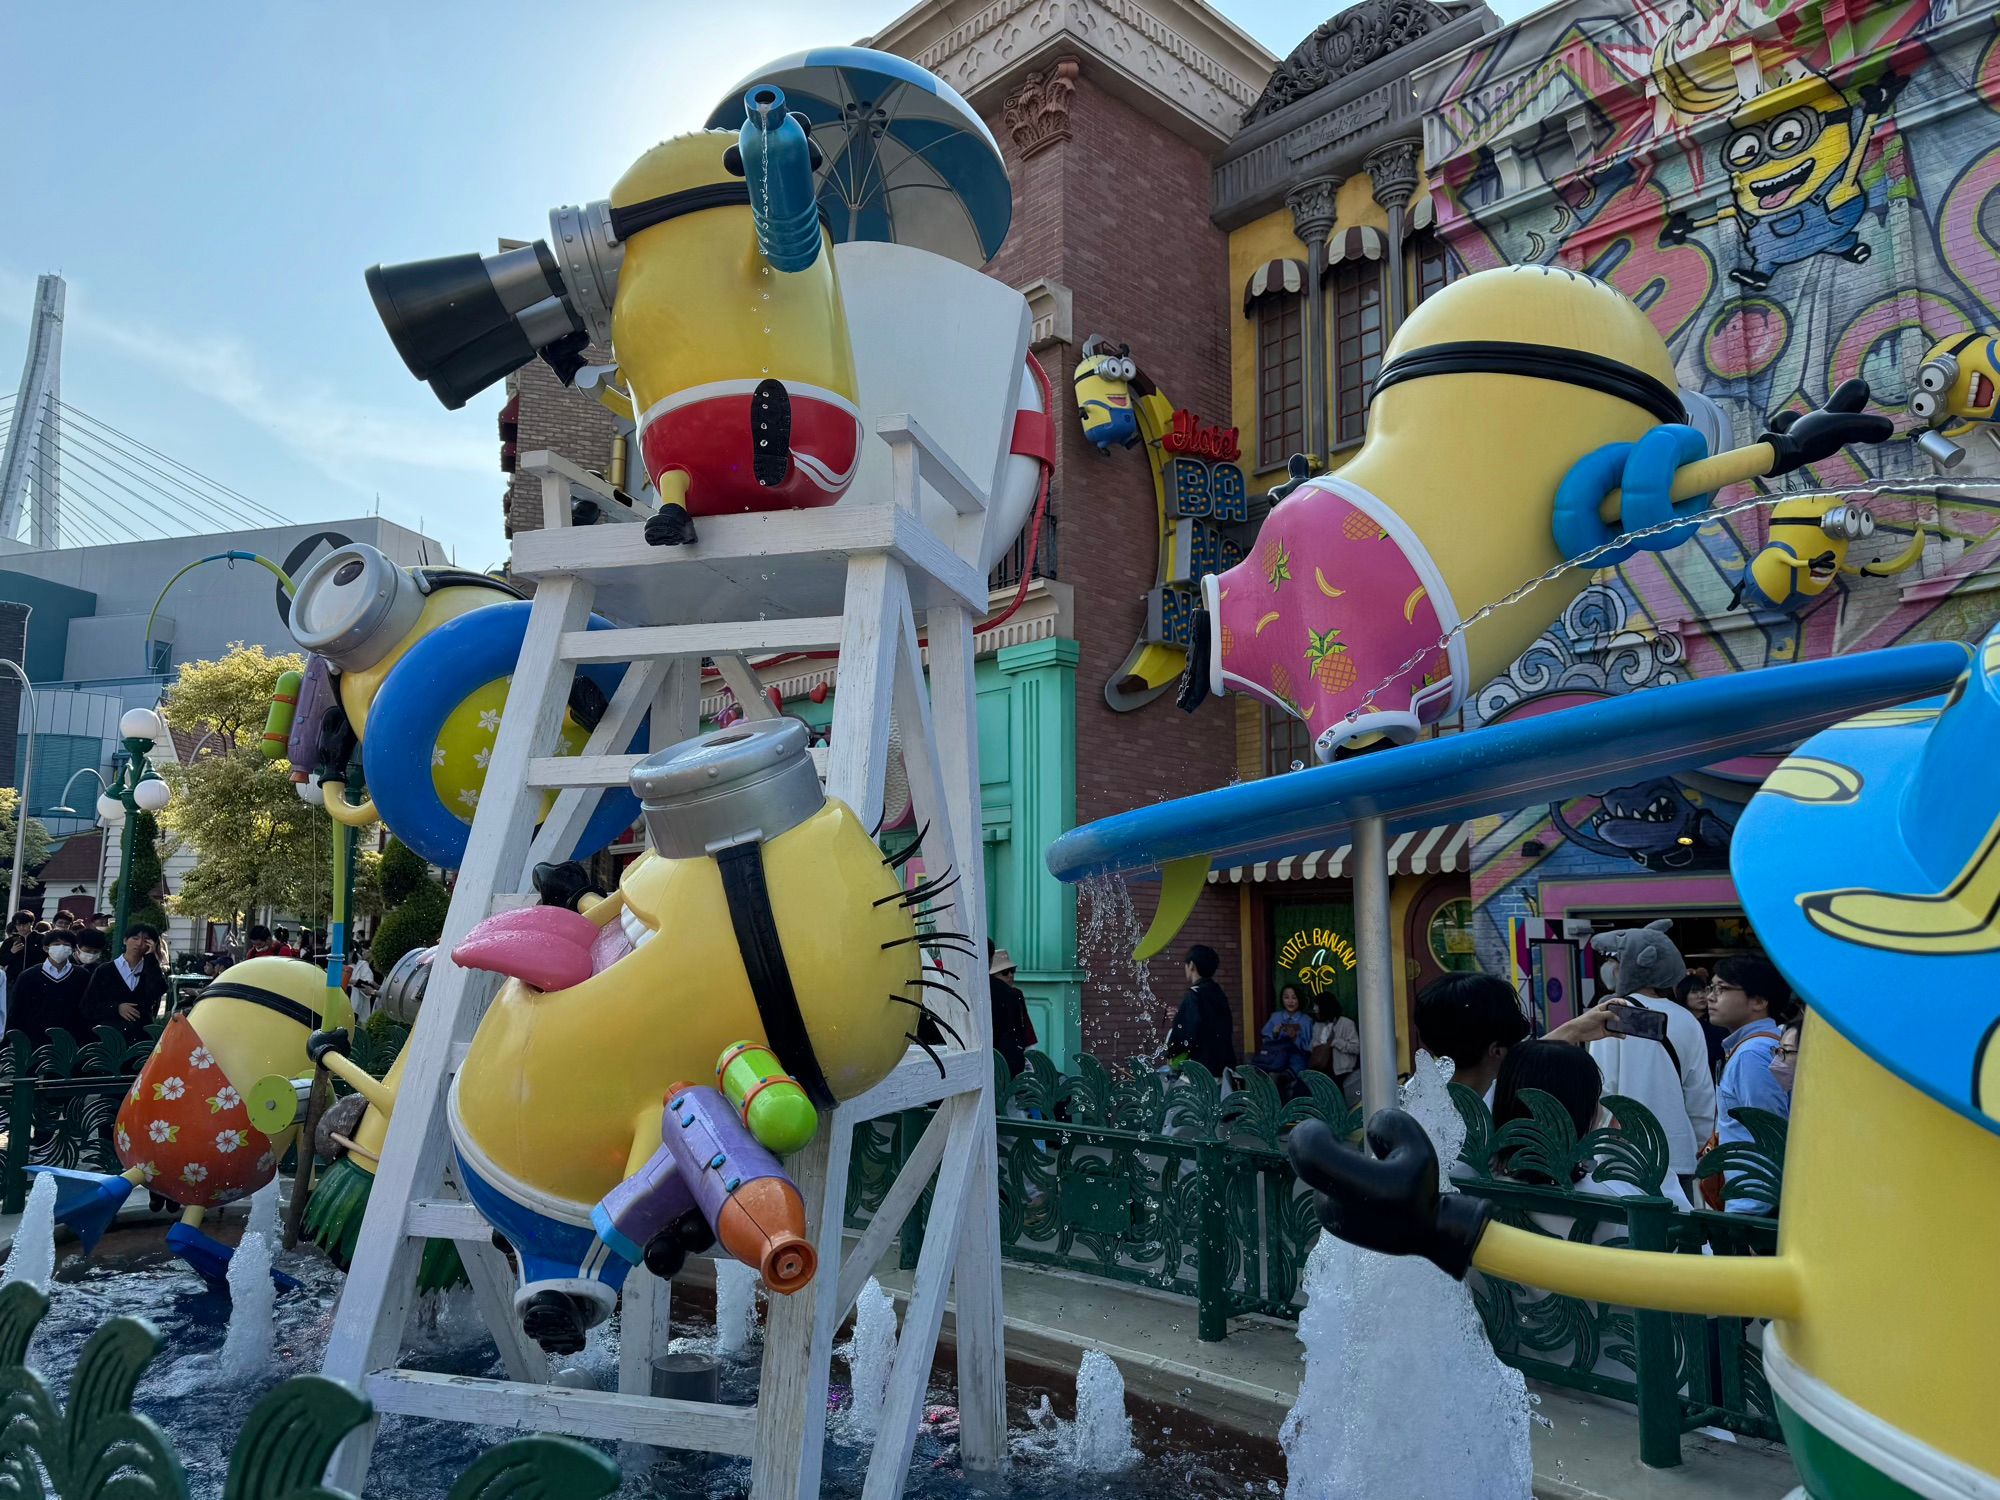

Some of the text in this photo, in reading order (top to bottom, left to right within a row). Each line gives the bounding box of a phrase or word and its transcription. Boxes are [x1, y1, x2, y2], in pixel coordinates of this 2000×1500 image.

[1327, 34, 1347, 61] HB
[1163, 408, 1241, 461] Hotel
[1278, 928, 1358, 970] HOTEL BANANA
